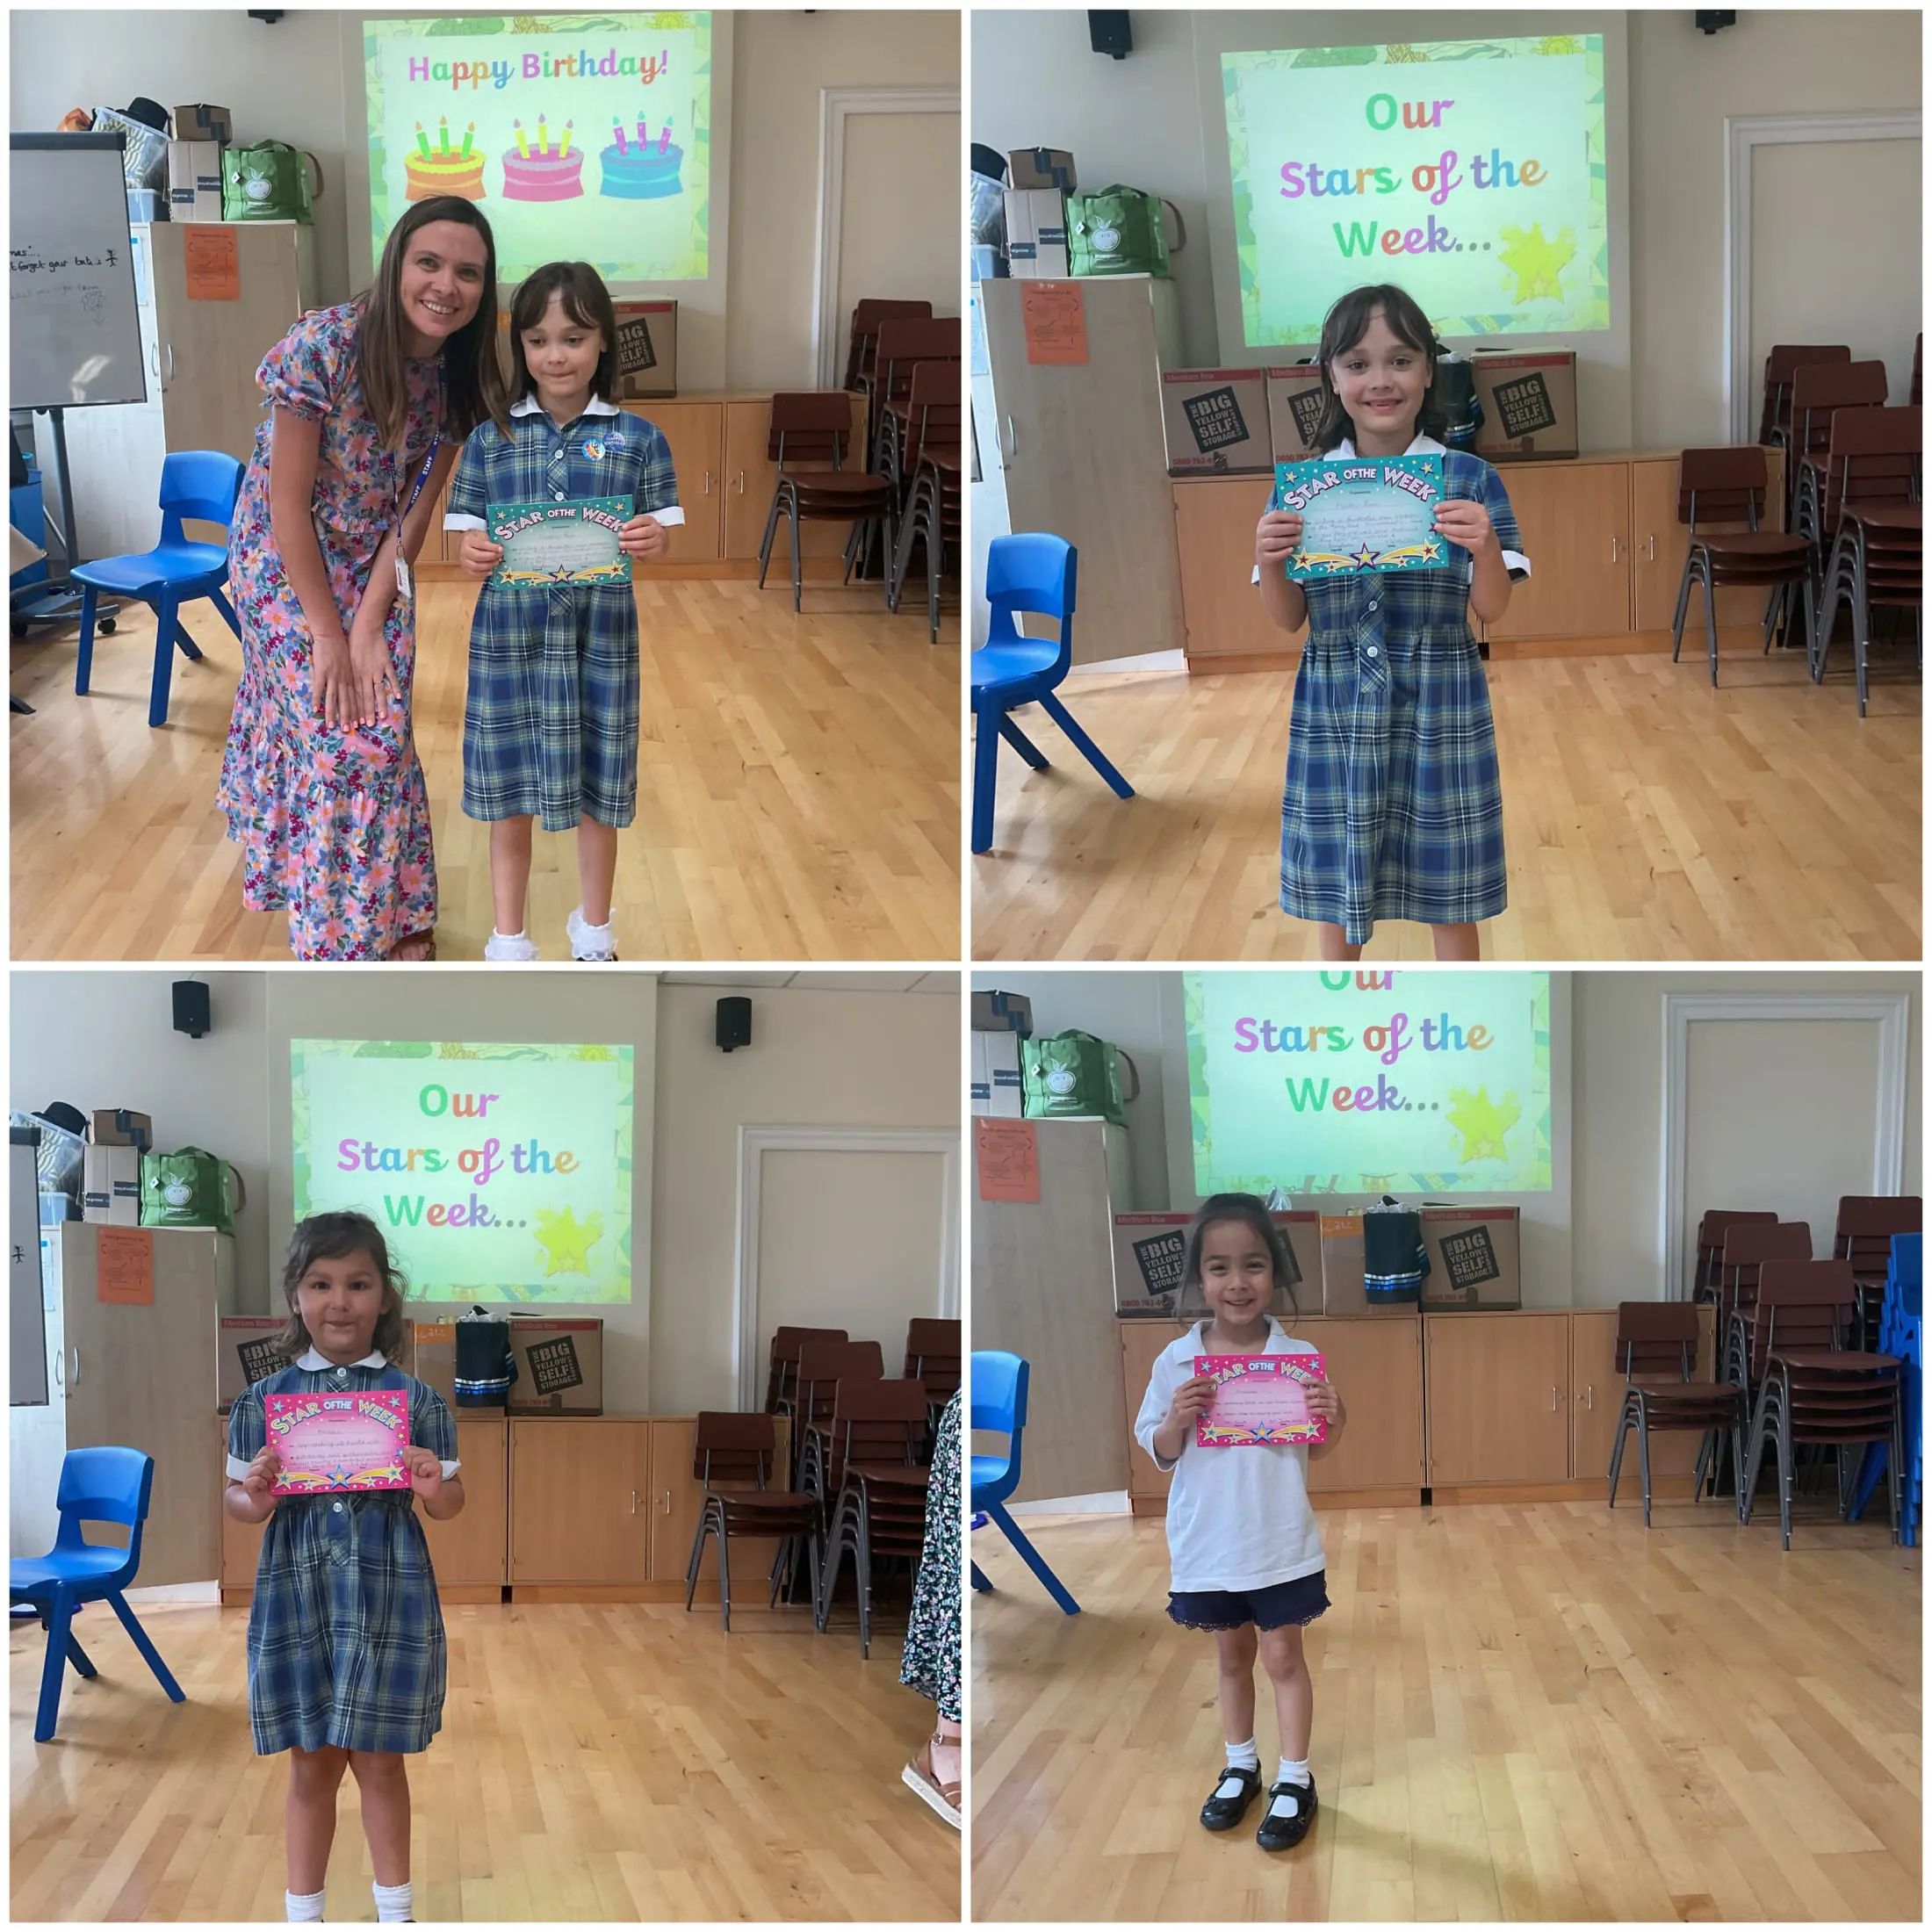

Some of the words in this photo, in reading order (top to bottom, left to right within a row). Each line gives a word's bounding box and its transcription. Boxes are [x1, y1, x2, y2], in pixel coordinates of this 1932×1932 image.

[409, 56, 515, 90] Happy
[522, 48, 667, 84] Birthday!
[1366, 93, 1454, 130] Our
[1280, 162, 1402, 198] Stars
[1411, 150, 1463, 205] of
[1470, 148, 1547, 189] the
[1332, 214, 1491, 257] Week...
[620, 347, 643, 363] ELF
[1506, 379, 1541, 402] BIG
[1197, 393, 1232, 416] BIG
[1302, 393, 1323, 412] BI
[1504, 396, 1539, 412] YELLOW
[1195, 410, 1229, 427] YELLOW
[1507, 404, 1540, 424] SELF
[1199, 418, 1232, 438] SELF
[422, 456, 433, 475] STAFF
[1283, 471, 1343, 510] STAR
[1384, 466, 1438, 502] WEEK
[494, 510, 544, 540] STAR
[1234, 1017, 1353, 1052] Stars
[1363, 1013, 1413, 1065] of
[1420, 1013, 1494, 1051] the
[419, 1084, 501, 1118] Our
[1285, 1073, 1438, 1113] Week...
[337, 1138, 449, 1171] Stars
[458, 1137, 504, 1186] of
[511, 1139, 579, 1173] the
[384, 1193, 526, 1228] Week...
[1147, 1237, 1183, 1258] BIG
[1453, 1233, 1486, 1254] BIG
[1145, 1253, 1179, 1268] YELLOW
[1450, 1248, 1483, 1264] YELLOW
[1453, 1256, 1484, 1275] SELF
[1149, 1261, 1182, 1281] SELF
[1152, 1275, 1182, 1289] STORAG
[248, 1355, 280, 1369] YELLOW
[539, 1343, 570, 1362] BIG
[536, 1357, 568, 1370] YELLOW
[538, 1364, 569, 1382] SELF
[1208, 1362, 1247, 1390] TAR
[1280, 1361, 1313, 1387] WEE
[270, 1402, 322, 1435] STAR
[358, 1399, 404, 1431] WEEK
